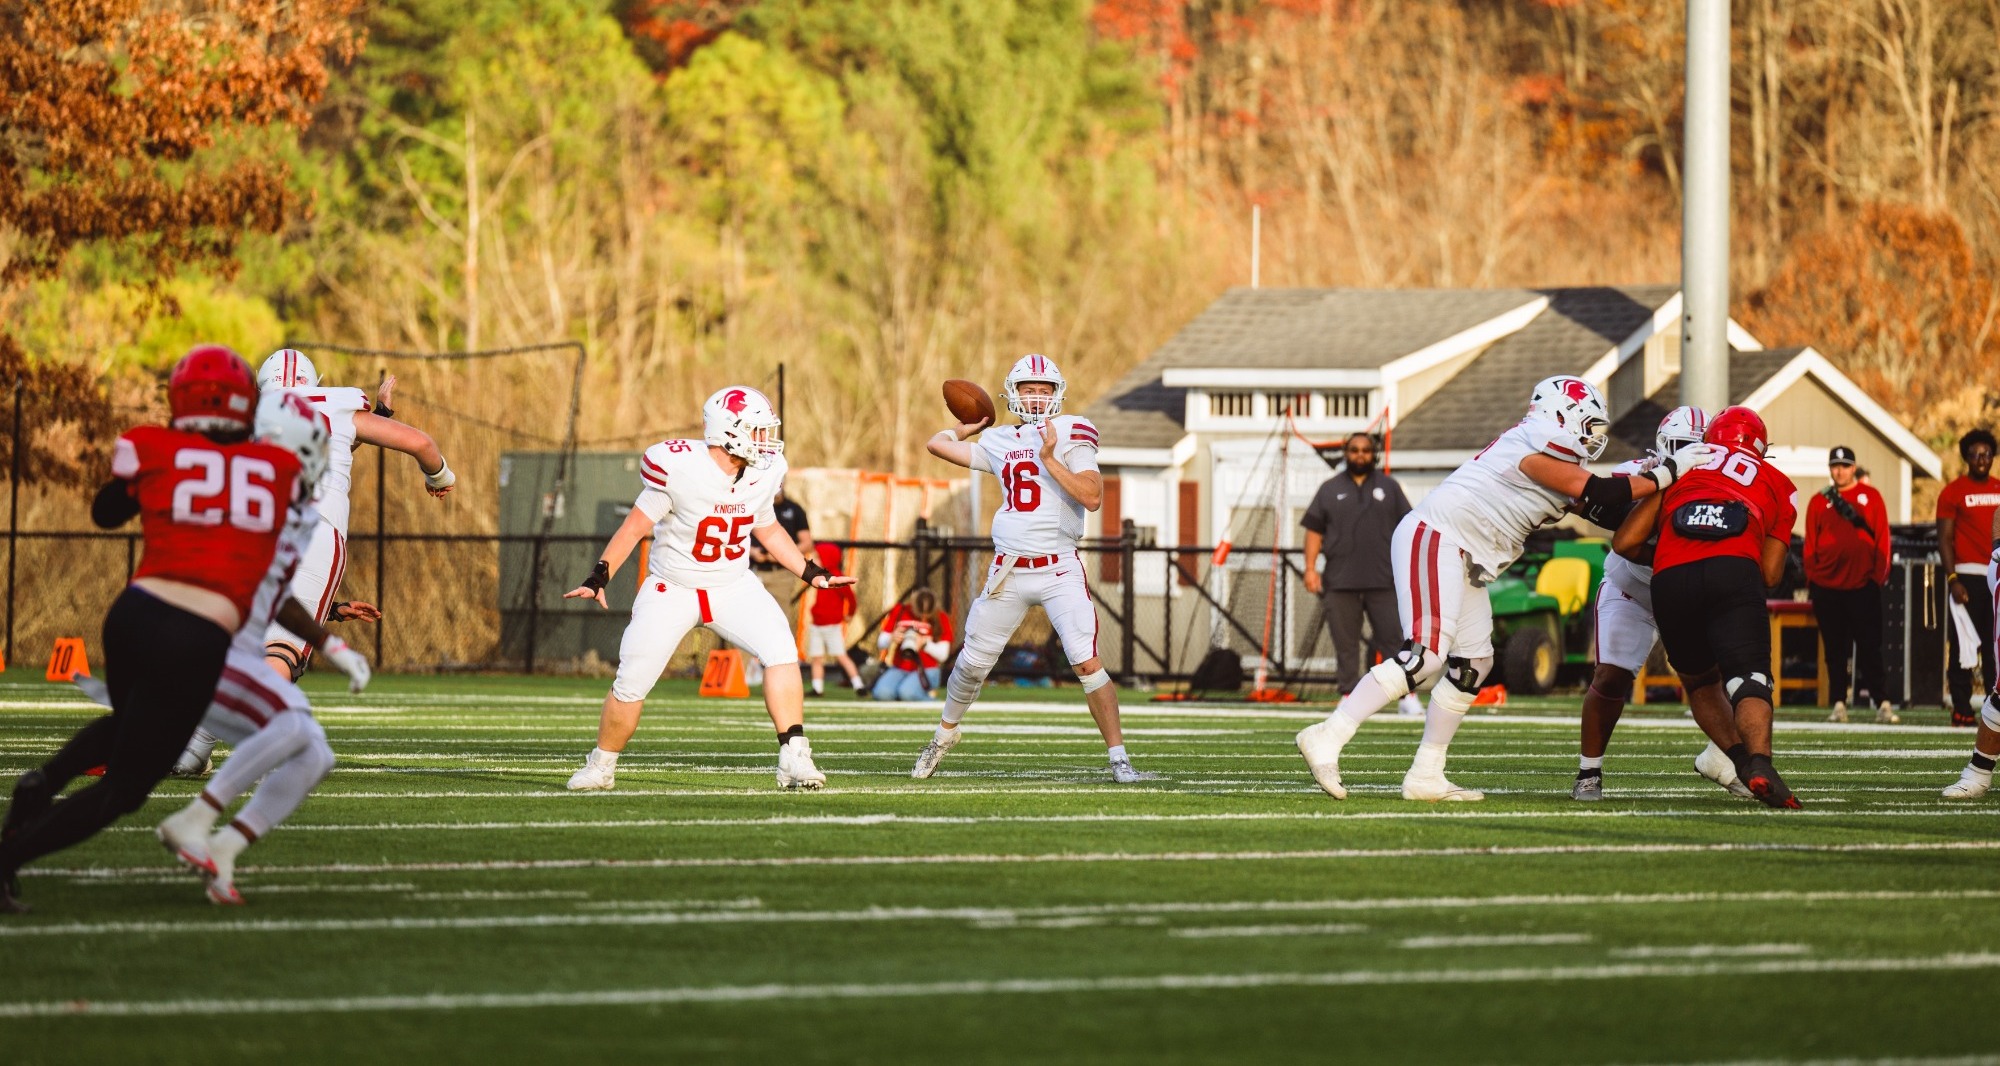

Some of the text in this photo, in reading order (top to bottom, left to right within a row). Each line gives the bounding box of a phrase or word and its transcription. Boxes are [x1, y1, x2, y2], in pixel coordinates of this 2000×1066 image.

[1004, 449, 1034, 461] KNIGHTS
[172, 447, 276, 533] 26
[1001, 461, 1041, 513] 16
[714, 503, 746, 514] KNIGHTS
[1694, 504, 1724, 518] I'M
[691, 514, 754, 563] 65
[52, 645, 73, 675] 10
[704, 656, 730, 688] 20
